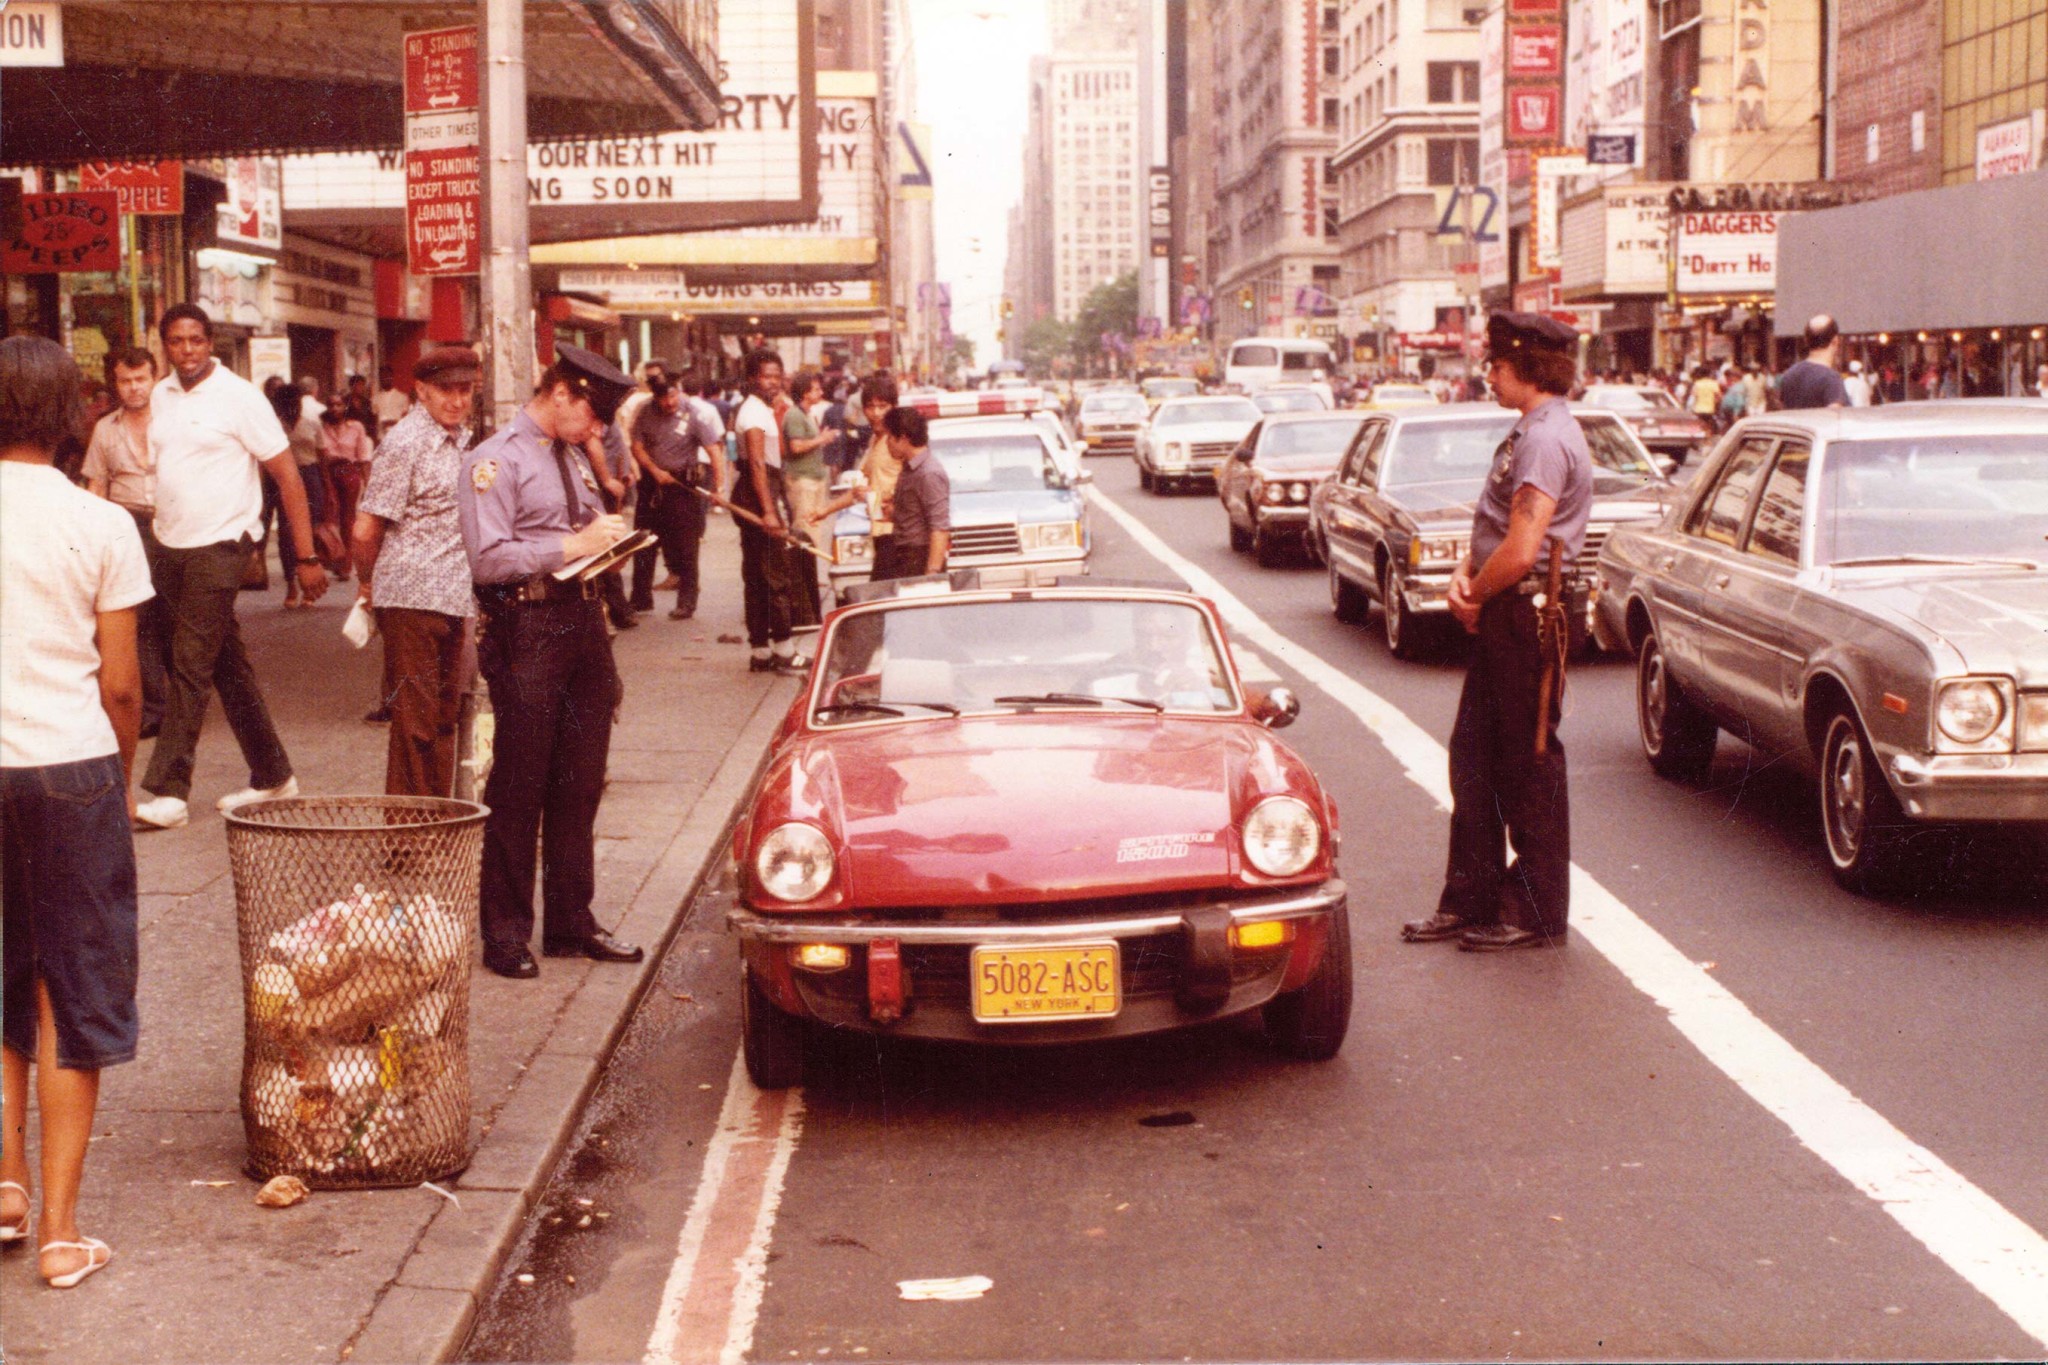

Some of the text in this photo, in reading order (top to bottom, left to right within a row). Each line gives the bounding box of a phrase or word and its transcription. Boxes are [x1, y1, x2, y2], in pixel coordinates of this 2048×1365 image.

[409, 31, 477, 56] NO STANDING
[412, 123, 477, 139] OTHER TIMES
[539, 143, 717, 167] OUR NEXT HIT
[409, 158, 479, 177] NO STANDING
[409, 179, 480, 200] EXCEPT TRUCKS
[593, 176, 673, 199] SOON
[417, 202, 474, 221] LOADING &
[416, 224, 476, 242] UNLOADING
[1686, 213, 1777, 236] DAGGERS
[764, 281, 842, 297] GANGS
[983, 961, 1109, 995] 5082-ASC
[1015, 997, 1081, 1010] NEW YORK
